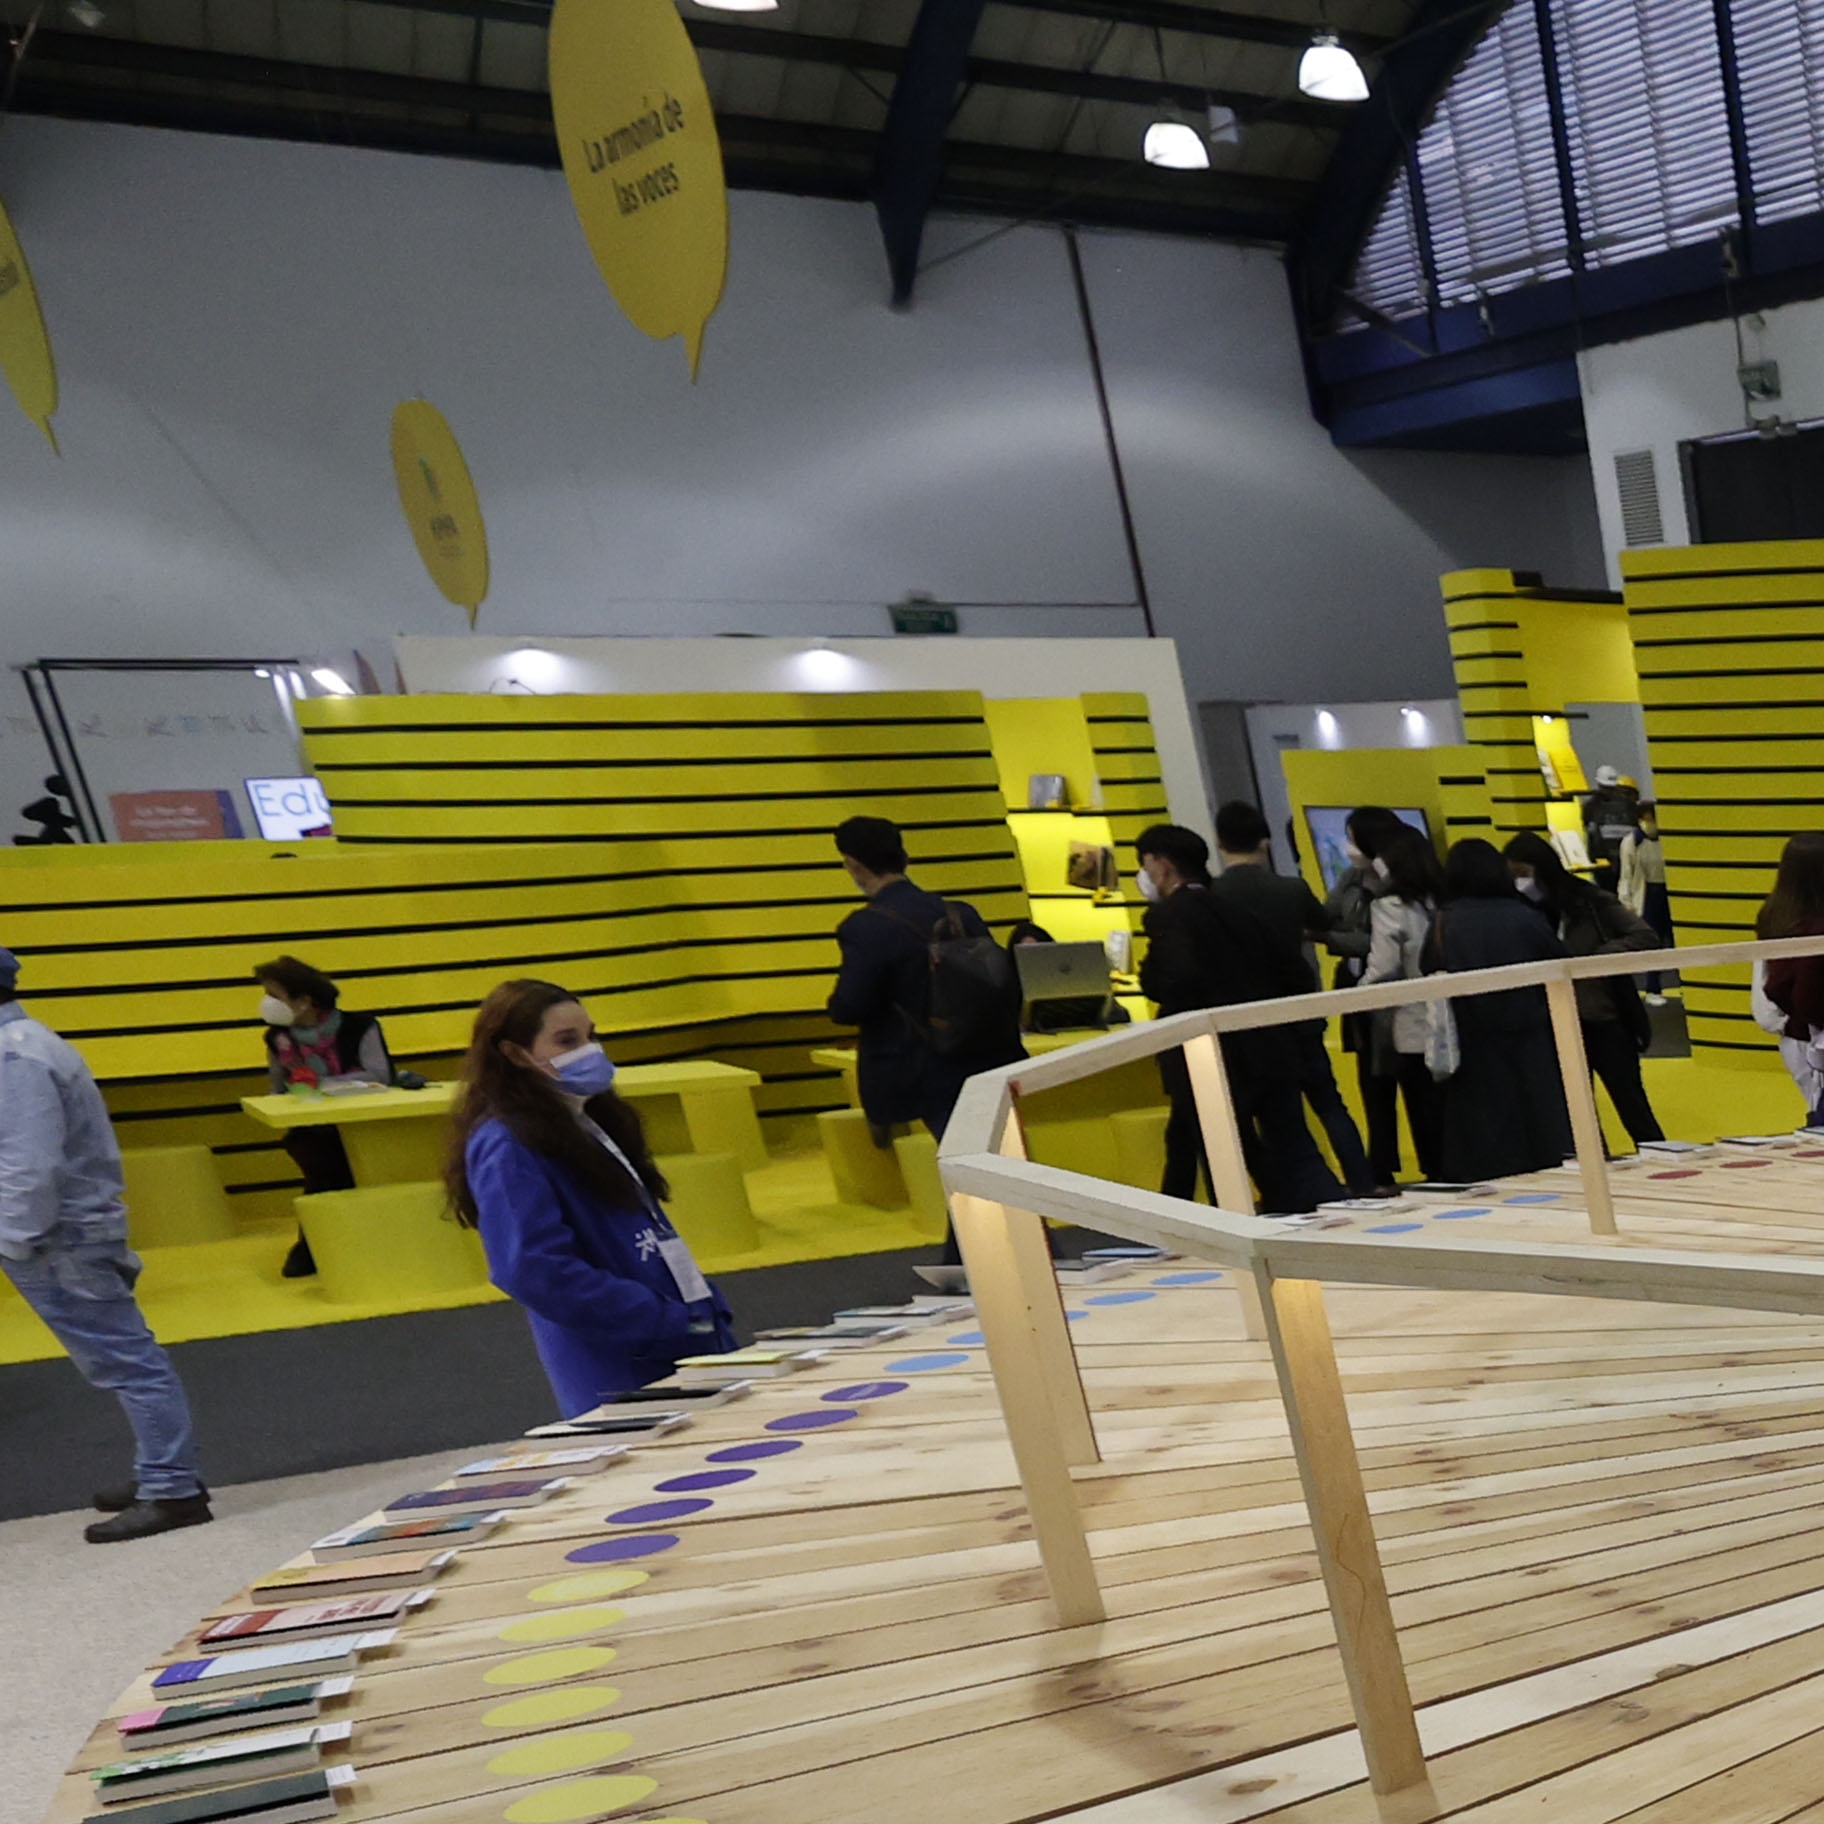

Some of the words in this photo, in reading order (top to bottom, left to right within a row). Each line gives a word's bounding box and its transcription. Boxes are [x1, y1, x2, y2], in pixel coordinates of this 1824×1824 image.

[582, 140, 605, 173] La
[604, 96, 664, 163] armonía
[664, 90, 684, 132] de
[611, 177, 640, 214] las
[637, 162, 679, 204] voces
